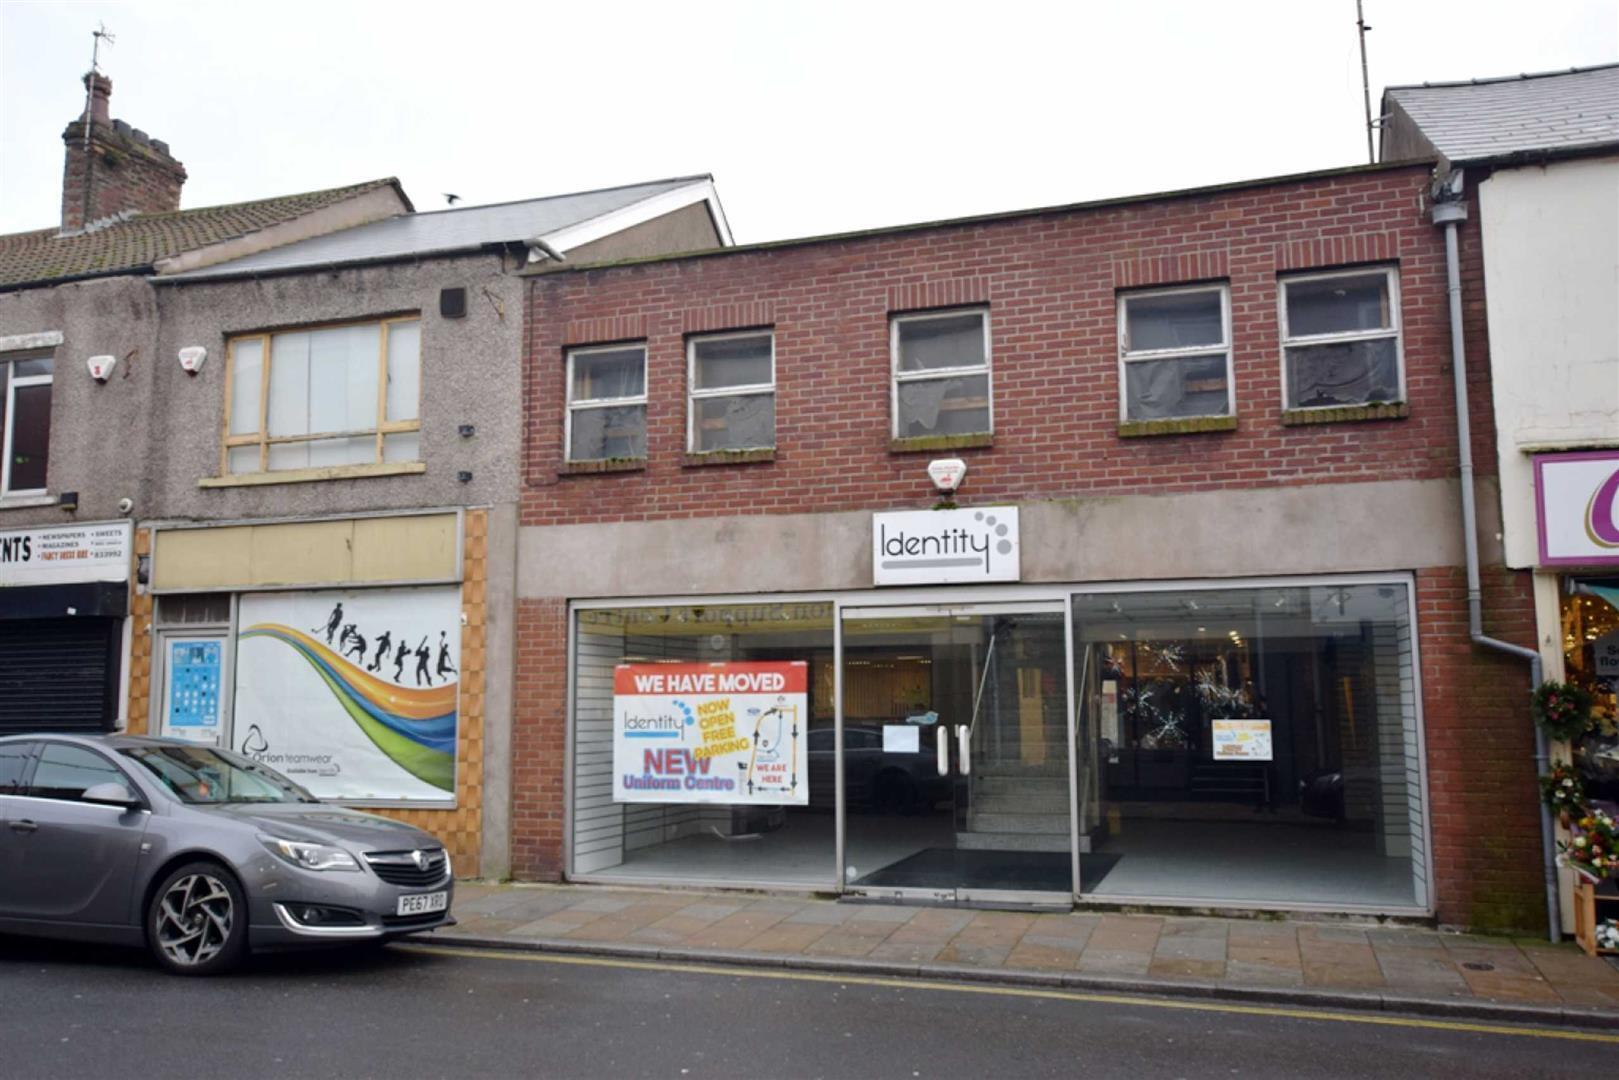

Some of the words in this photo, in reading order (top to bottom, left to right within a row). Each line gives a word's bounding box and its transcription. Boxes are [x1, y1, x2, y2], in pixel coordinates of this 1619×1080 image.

[43, 532, 86, 540] NEWSPAPERS
[0, 536, 31, 562] NTS
[42, 541, 79, 549] MAGAZINES
[881, 523, 989, 574] Identity
[634, 675, 663, 692] WE
[667, 674, 716, 692] HAVE
[719, 673, 785, 691] MOVED
[697, 698, 730, 715] NOW
[624, 710, 685, 741] Identity
[699, 712, 735, 729] OPEN
[702, 727, 736, 743] FREE
[694, 737, 749, 760] PARKING
[252, 752, 284, 763] Orion
[285, 753, 333, 763] teamwear
[643, 748, 712, 774] NEW
[756, 764, 769, 772] WE
[771, 764, 787, 772] ARE
[623, 774, 681, 790] Uniform
[684, 775, 735, 791] Centre
[761, 775, 783, 783] HERE
[402, 895, 428, 912] PE67
